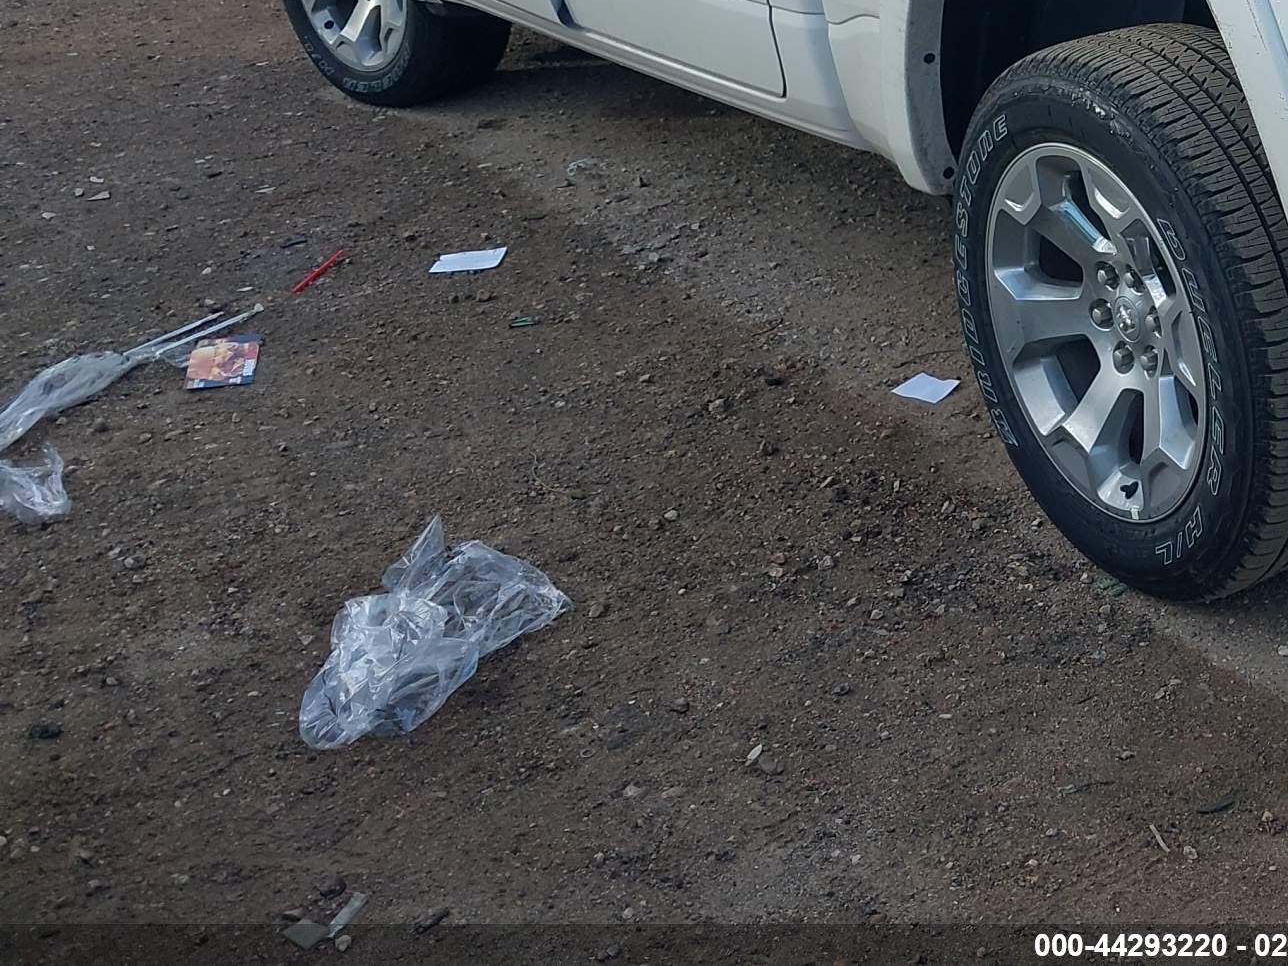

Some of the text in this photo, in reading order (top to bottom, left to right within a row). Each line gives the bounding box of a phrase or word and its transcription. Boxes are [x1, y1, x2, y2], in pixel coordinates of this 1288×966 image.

[954, 114, 1012, 447] BRIDGESTONE
[1155, 217, 1228, 565] DUELER H/L
